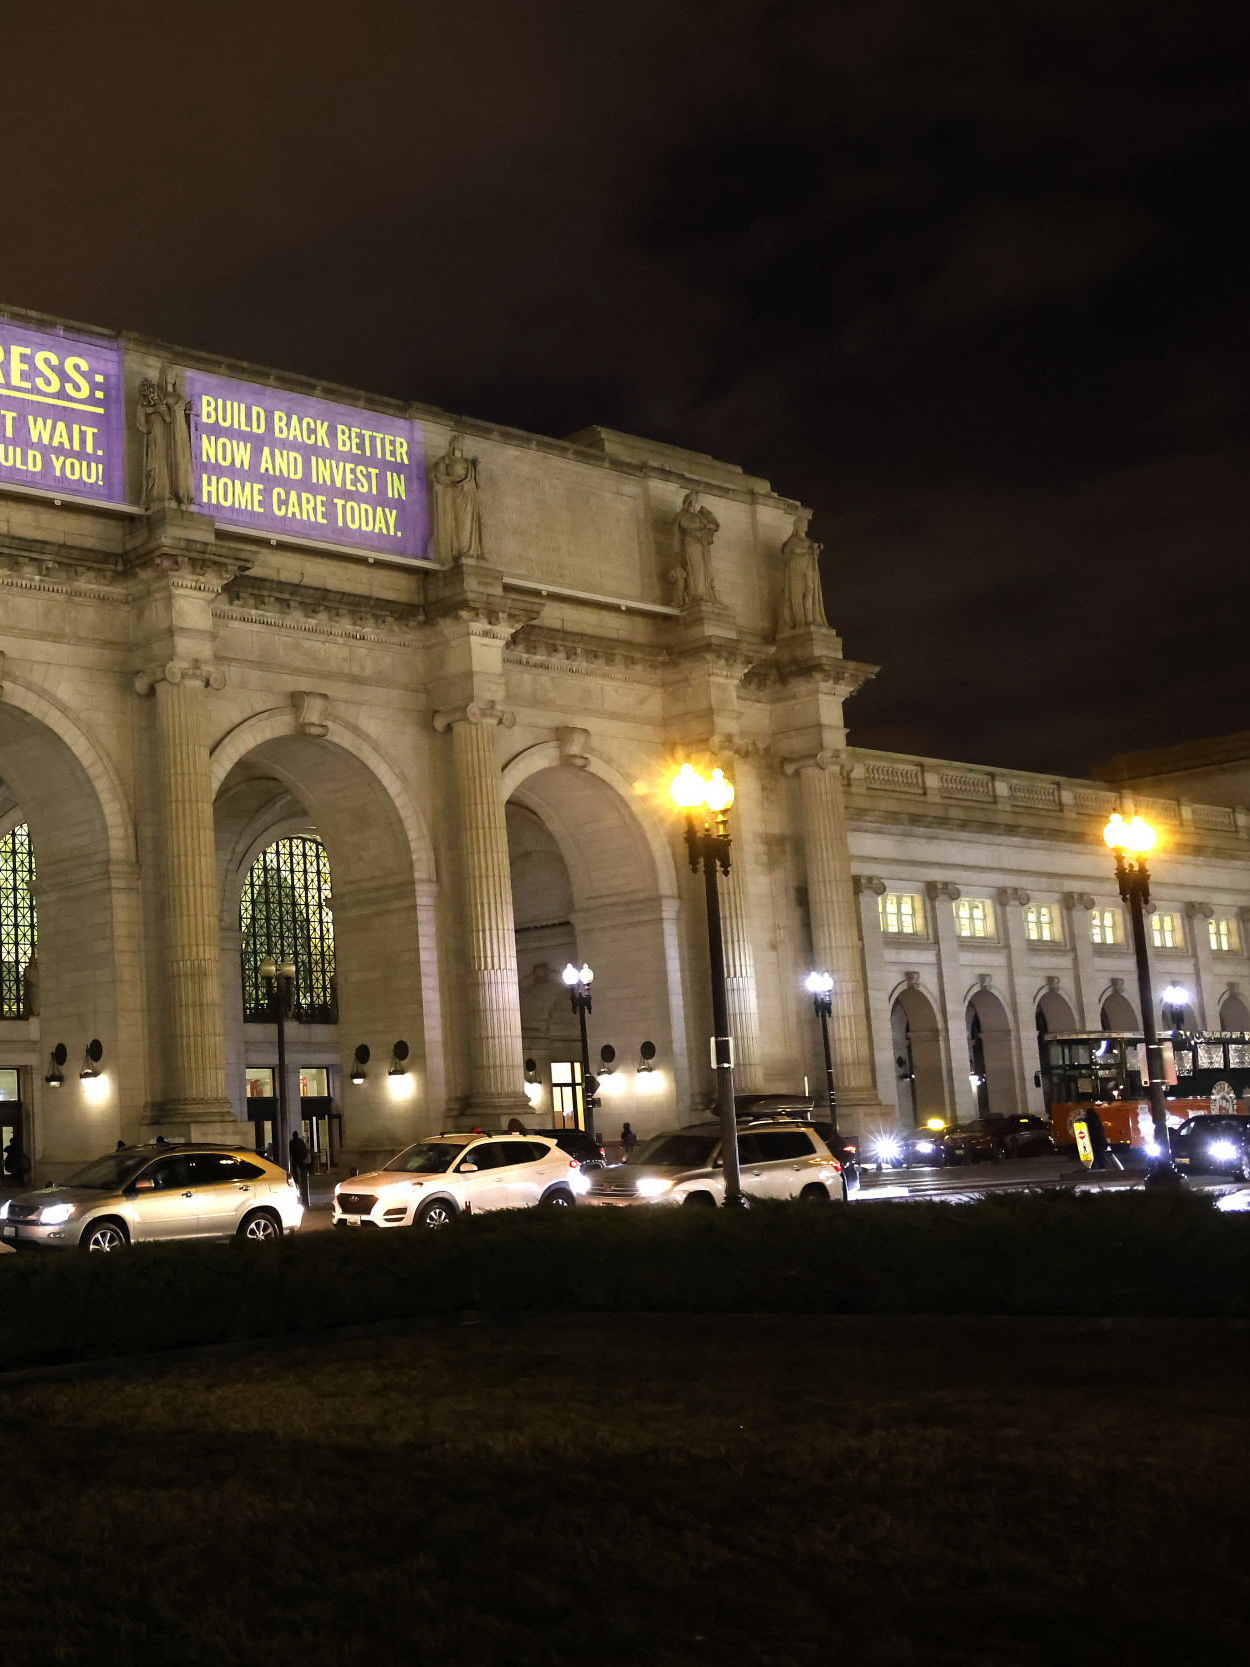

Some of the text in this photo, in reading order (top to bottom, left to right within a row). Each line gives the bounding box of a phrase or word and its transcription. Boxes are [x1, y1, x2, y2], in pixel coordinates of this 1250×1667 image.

[27, 415, 104, 456] WAIT.
[201, 394, 409, 465] BUILD BACK BETTER
[50, 454, 104, 485] YOU!
[201, 433, 406, 501] NOW AND INVEST IN
[201, 473, 402, 537] HOME CARE TODAY.
